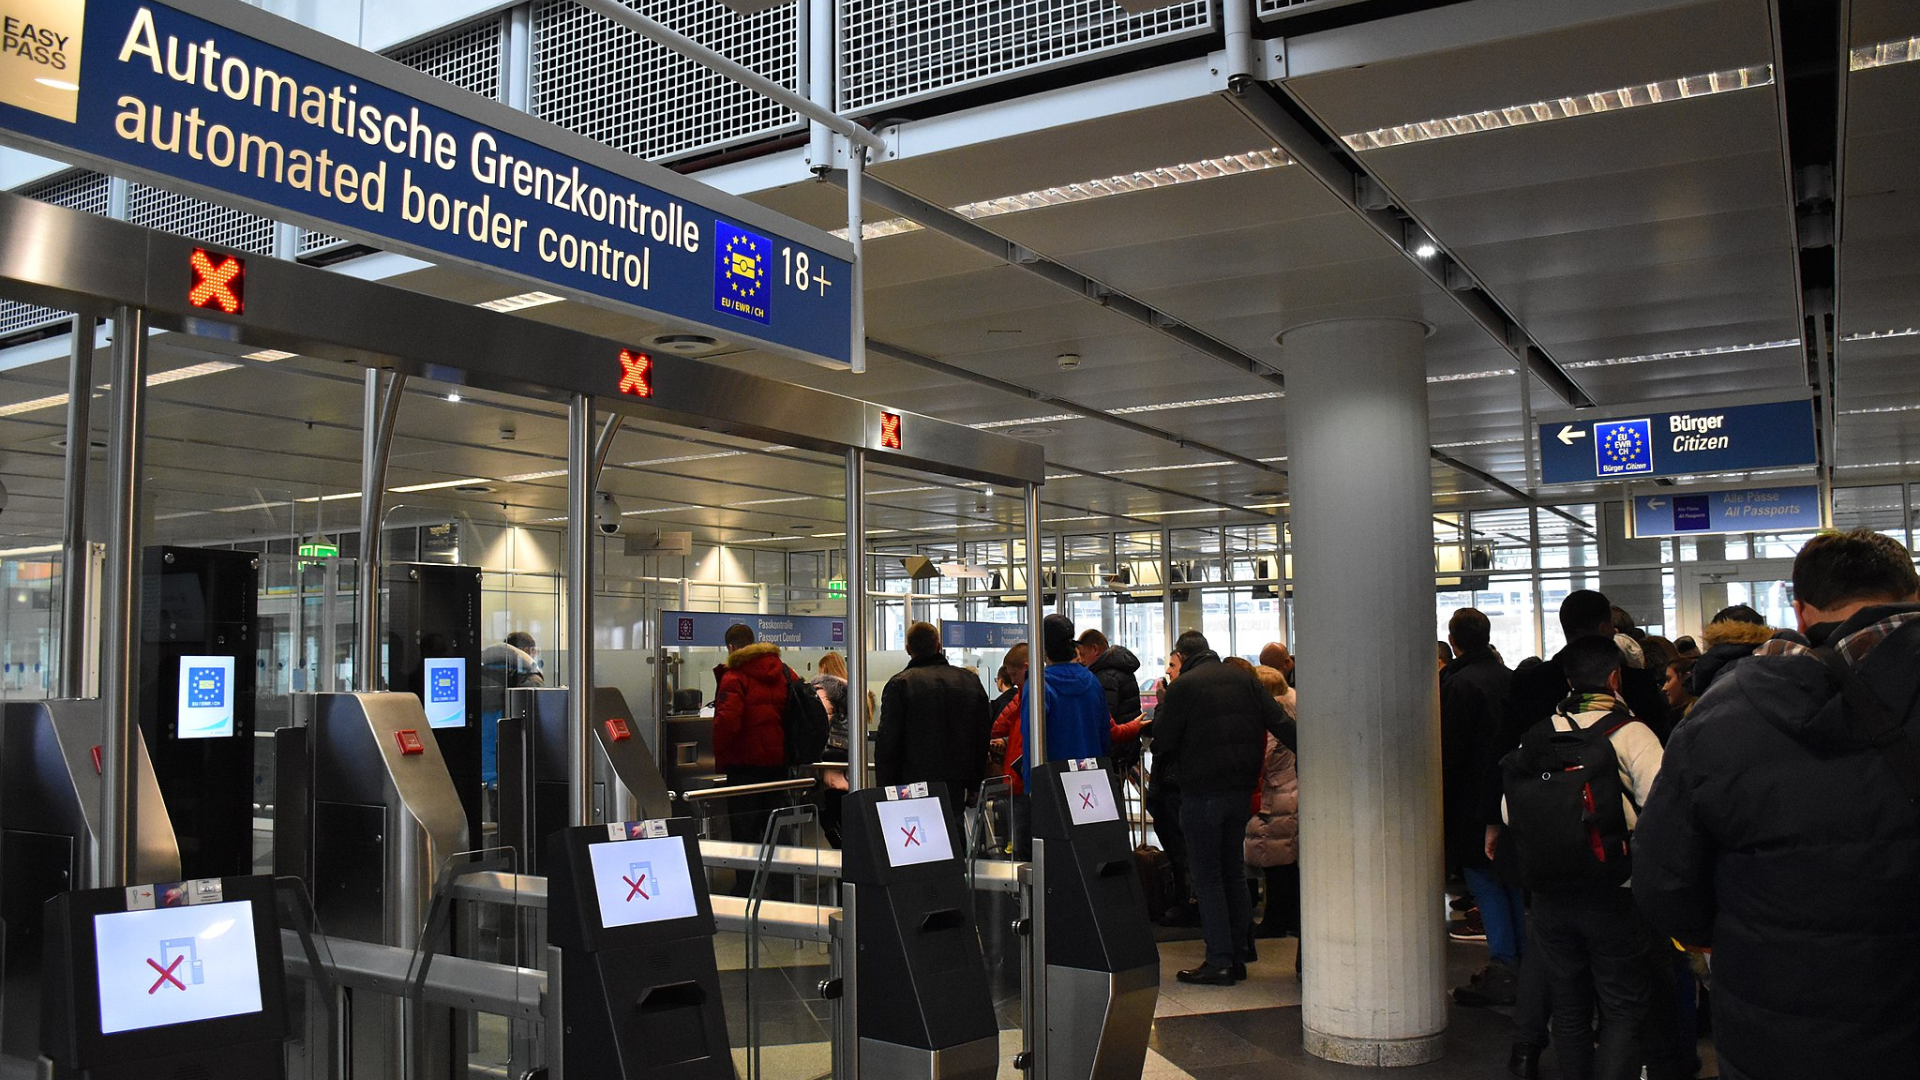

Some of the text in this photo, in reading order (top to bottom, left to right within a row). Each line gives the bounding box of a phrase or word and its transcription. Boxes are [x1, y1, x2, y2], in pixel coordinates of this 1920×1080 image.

[4, 16, 69, 51] EASY
[3, 35, 66, 70] PASS
[118, 7, 700, 253] Automatische Grenzkontrolle
[115, 94, 650, 290] automated border control
[782, 246, 832, 297] 18+
[1670, 414, 1724, 433] Bürger
[1614, 440, 1631, 448] EWR
[1672, 434, 1729, 452] Citizen
[1724, 492, 1744, 503] Alle
[1725, 504, 1800, 518] All Passports
[758, 619, 793, 630] Passkontrolle
[758, 631, 801, 642] Passport Control
